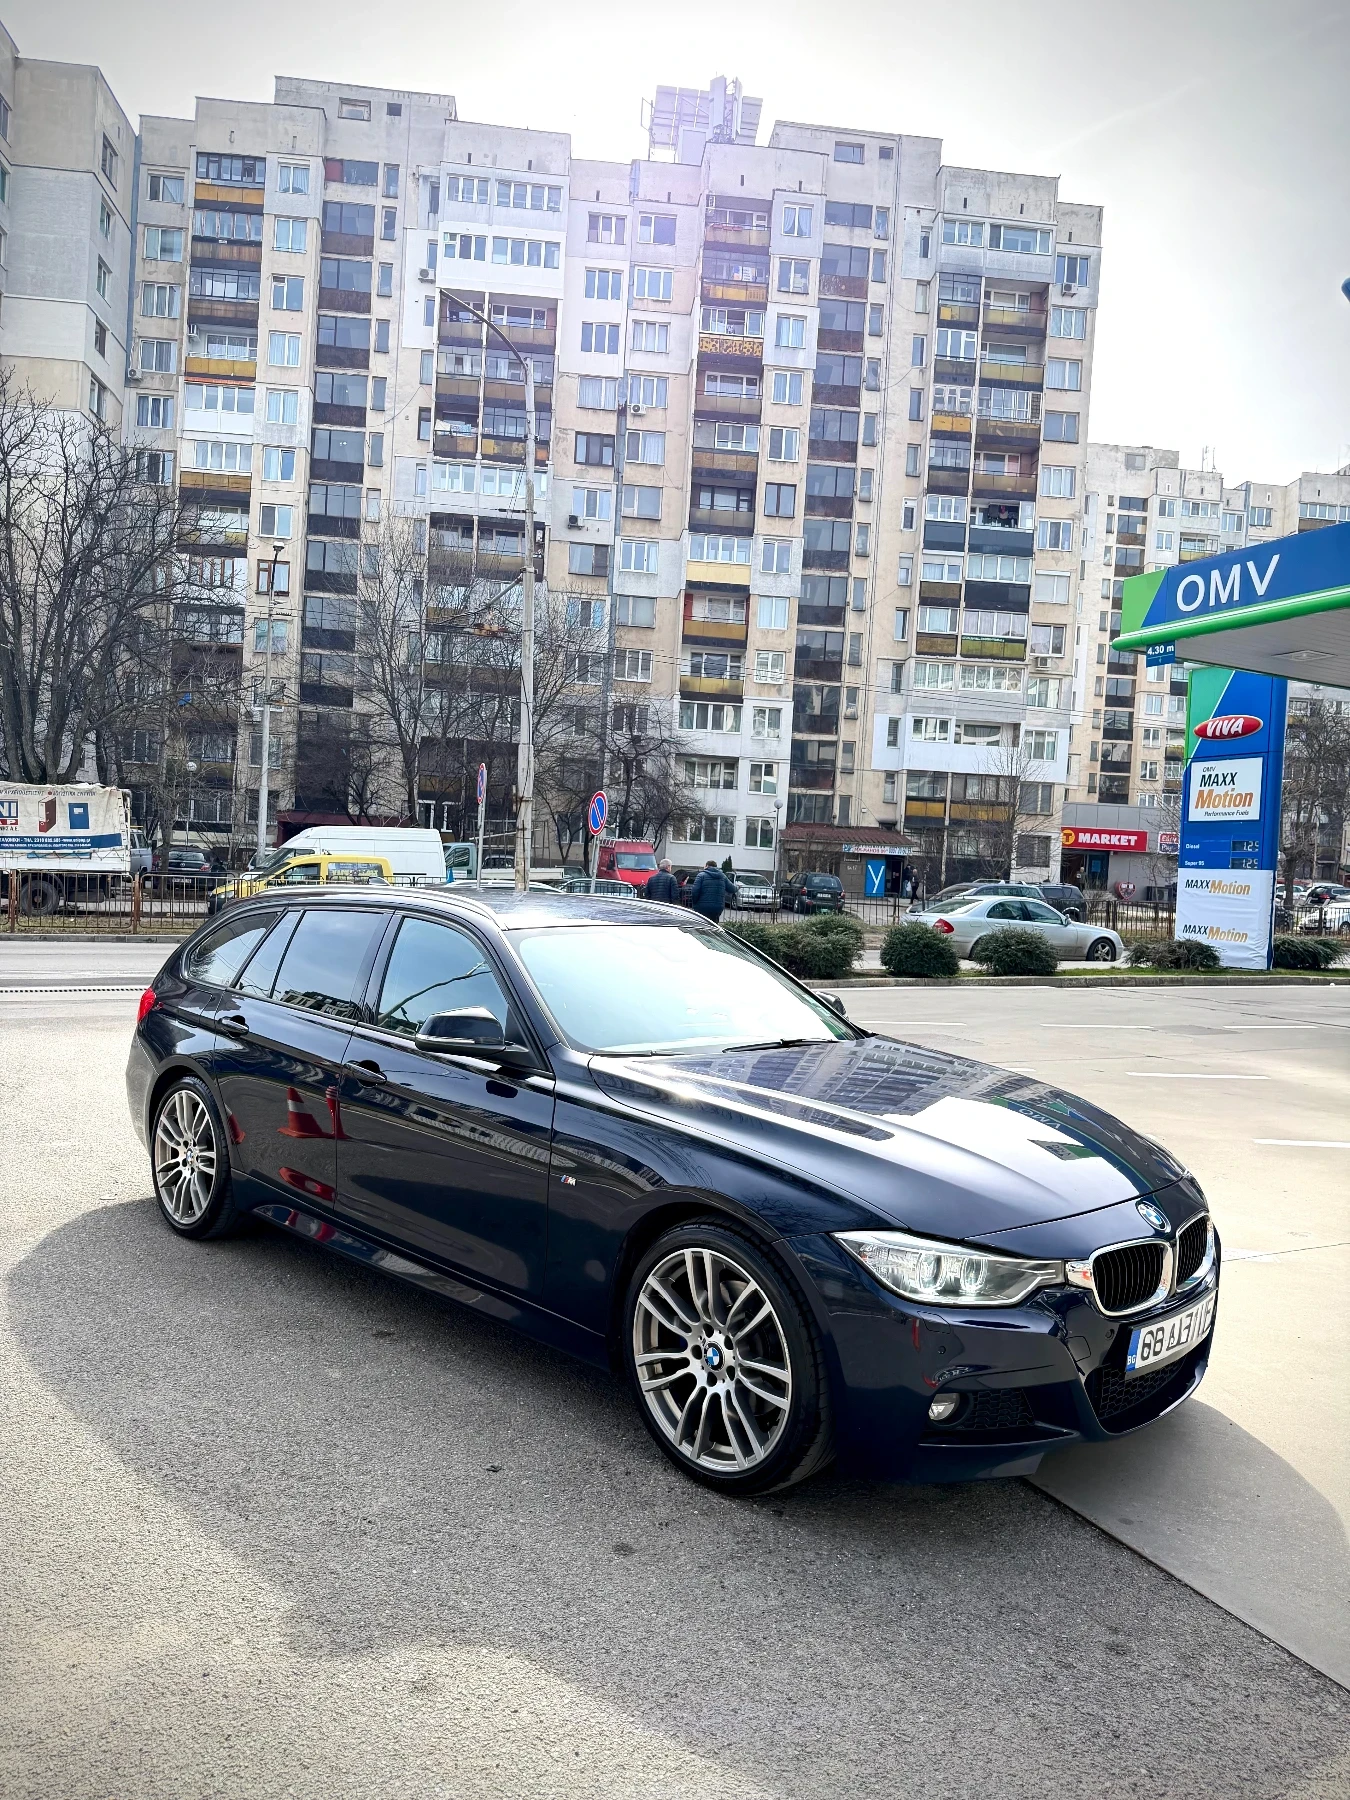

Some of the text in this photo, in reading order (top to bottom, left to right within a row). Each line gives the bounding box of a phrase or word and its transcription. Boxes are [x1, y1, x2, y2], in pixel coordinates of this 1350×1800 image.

[1176, 554, 1280, 612] OMV
[1147, 645, 1165, 655] 4.30
[1206, 717, 1244, 737] VIVA
[1199, 772, 1238, 787] MAXX
[1194, 788, 1253, 809] Motion
[1078, 833, 1138, 846] MARKET
[1127, 1354, 1136, 1365] BG
